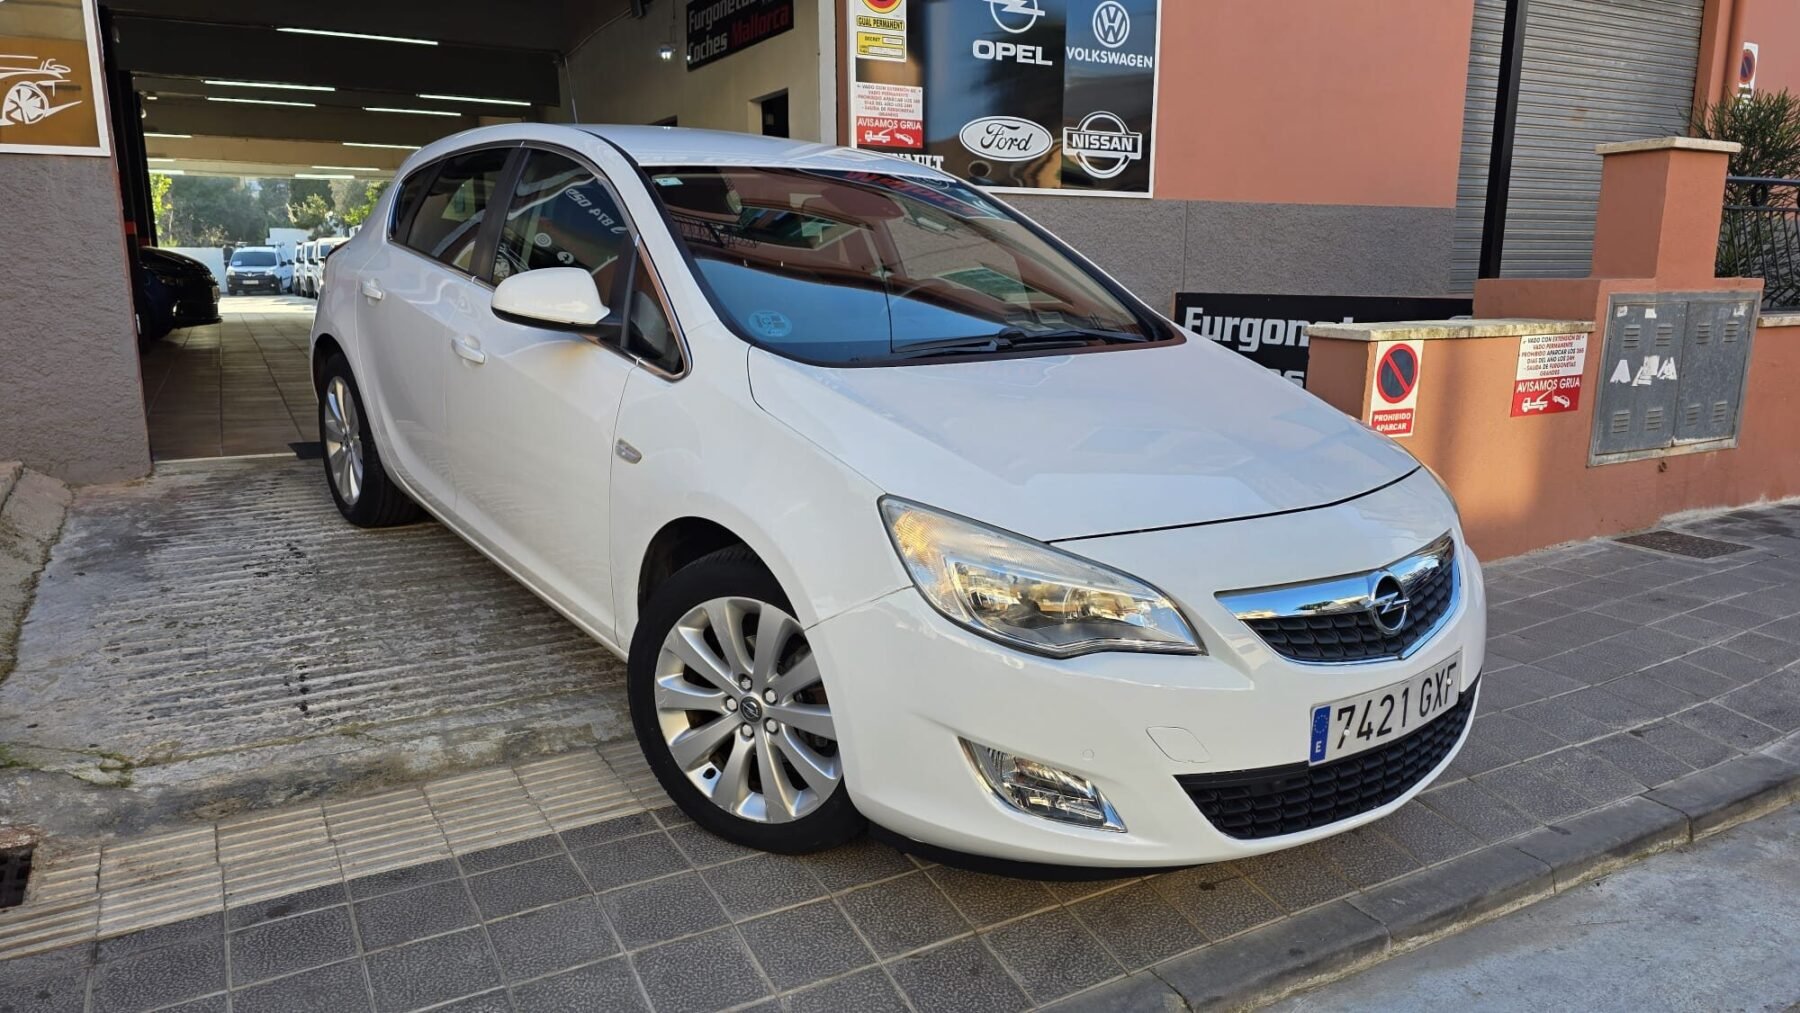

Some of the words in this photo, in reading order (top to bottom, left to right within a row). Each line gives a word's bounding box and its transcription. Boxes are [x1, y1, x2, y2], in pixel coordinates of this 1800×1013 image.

[872, 18, 903, 30] PERMANENT
[688, 32, 728, 64] Coches
[732, 5, 789, 48] Mallorca
[972, 39, 1053, 66] OPEL
[1065, 46, 1153, 69] VOLKSWAGEN
[857, 117, 899, 128] AVISAMOS
[900, 120, 922, 130] GRUA
[980, 122, 1033, 151] Ford
[1072, 133, 1133, 152] NISSAN
[1516, 378, 1558, 393] AVISAMOS
[1559, 377, 1580, 389] GRUA
[1373, 412, 1411, 422] PROHIBIDO
[1337, 686, 1410, 750] 7421
[1419, 662, 1457, 718] GXF
[1315, 740, 1322, 753] E
